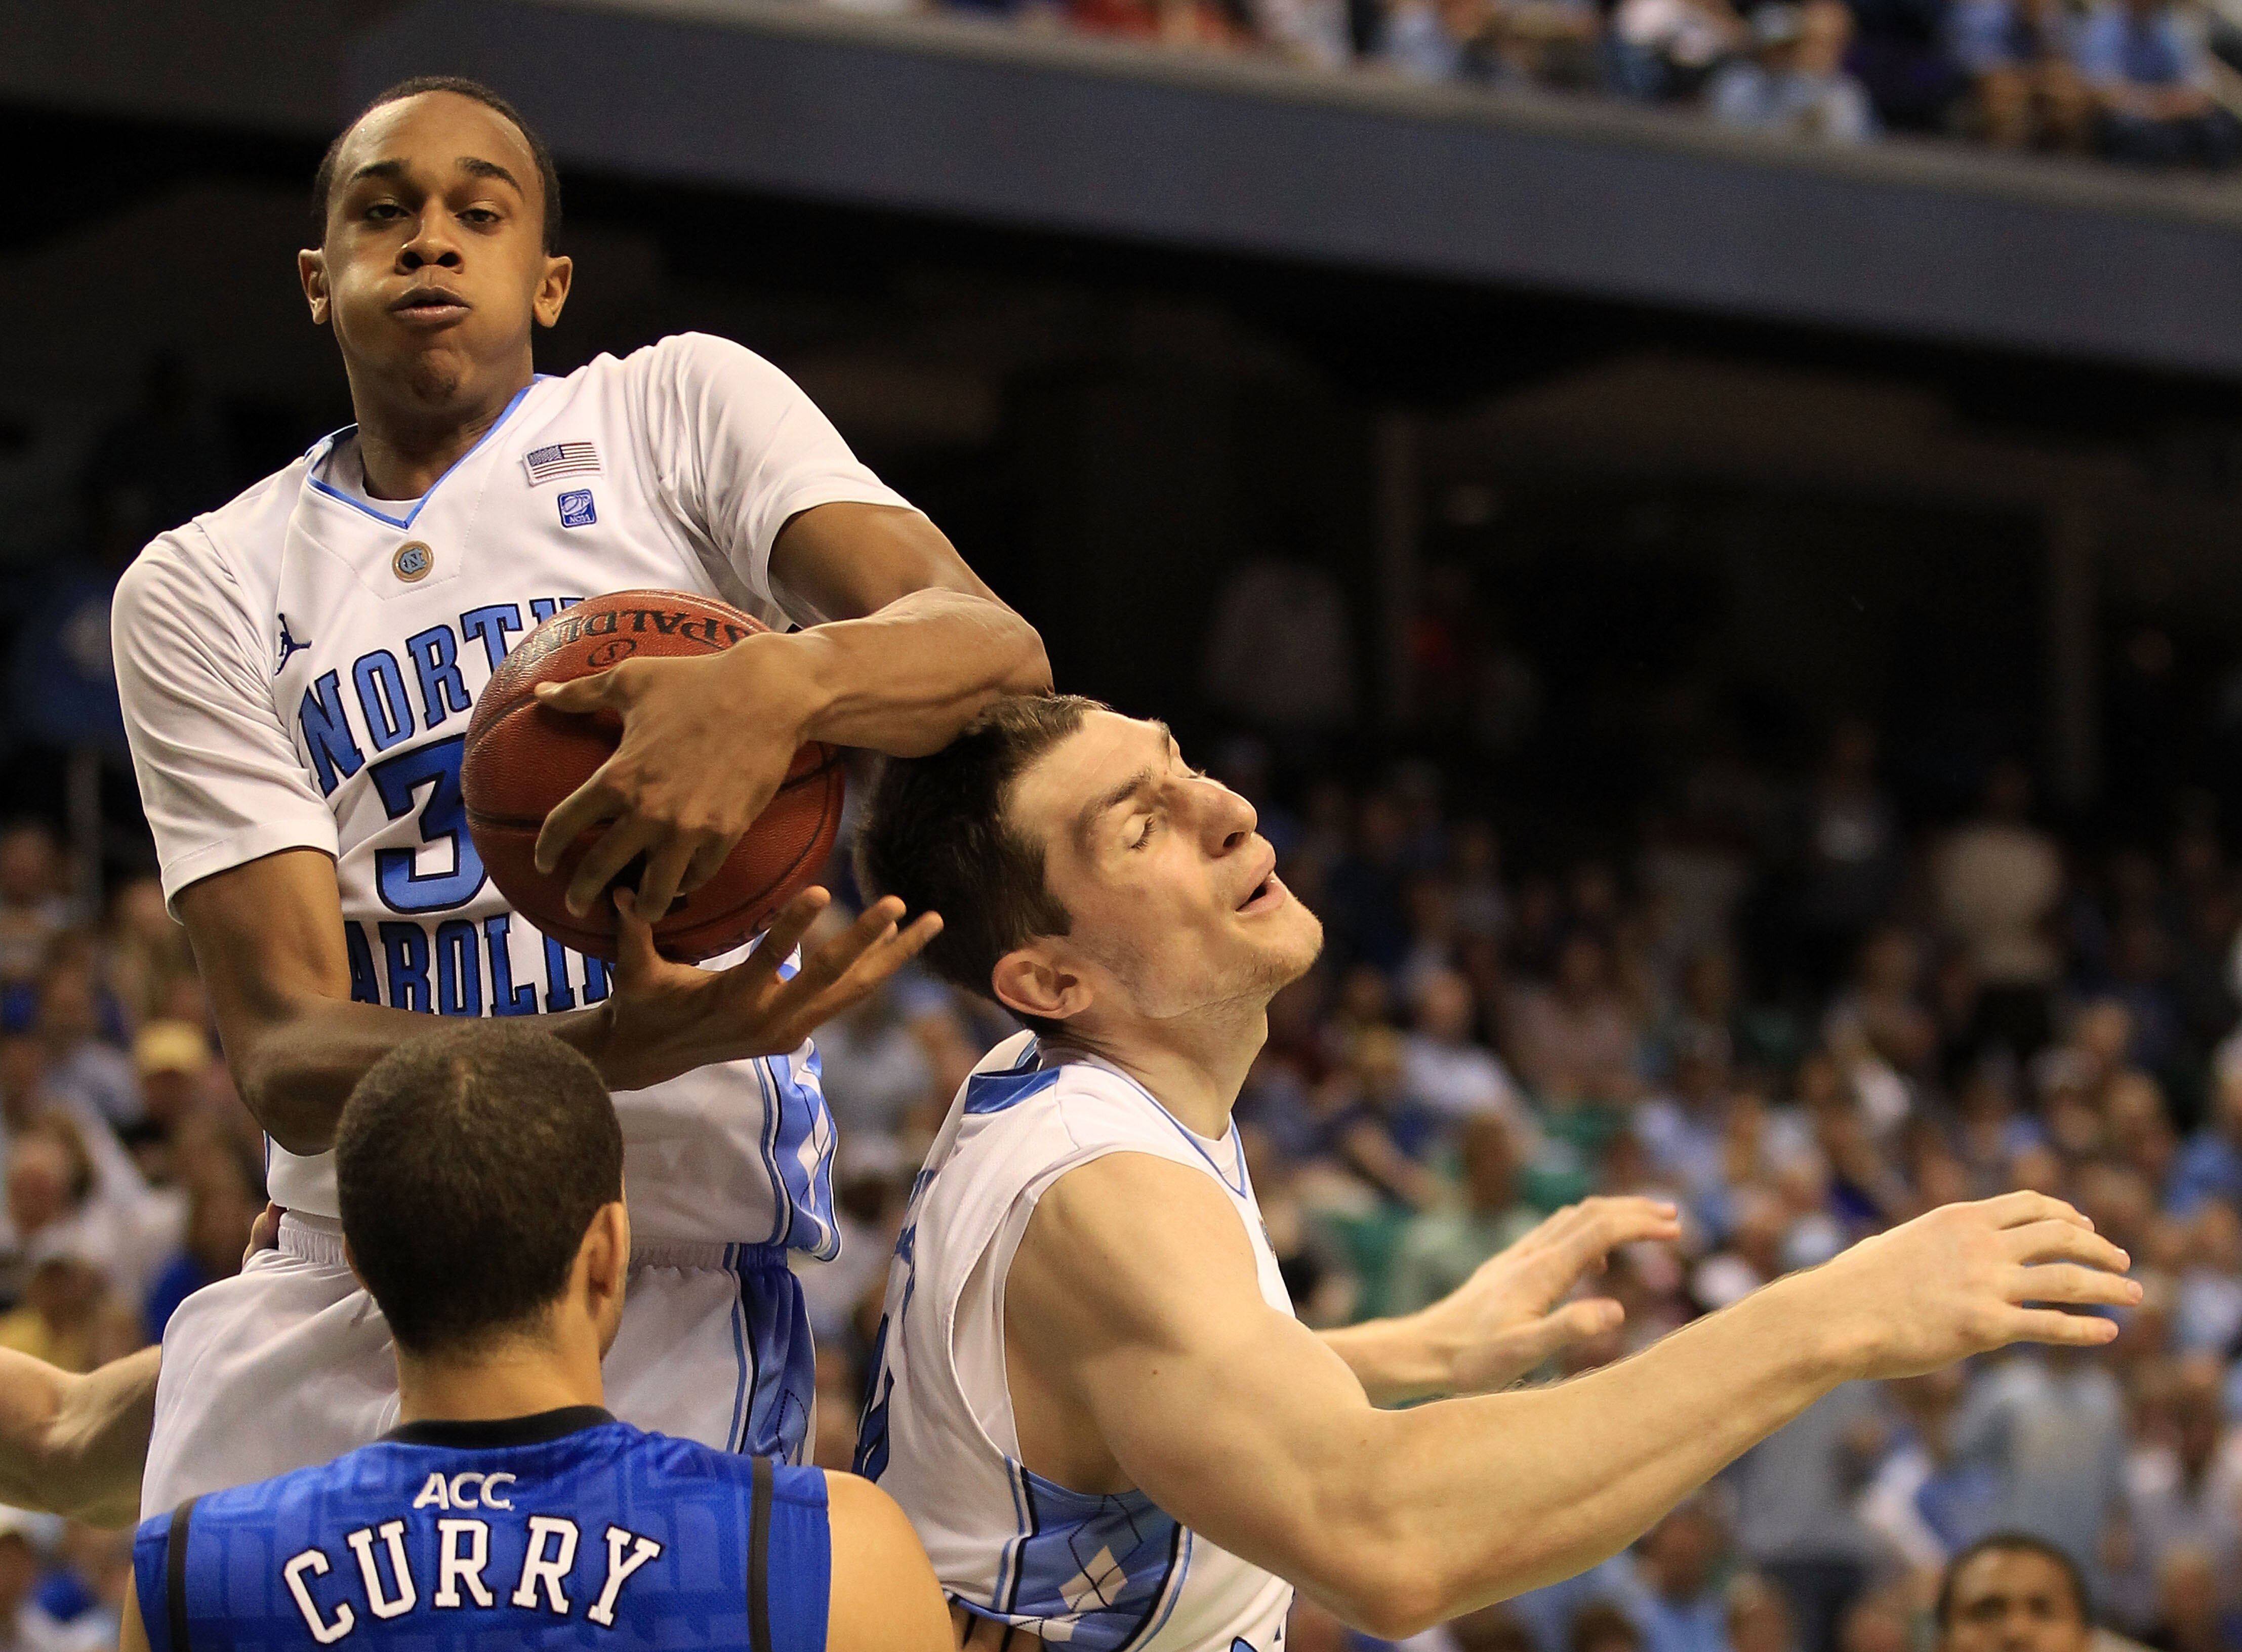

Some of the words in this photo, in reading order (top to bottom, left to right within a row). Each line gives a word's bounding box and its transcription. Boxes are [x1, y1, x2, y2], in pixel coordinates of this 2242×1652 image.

[299, 596, 585, 798] NORT
[413, 1472, 516, 1511] ACC
[282, 1515, 662, 1644] CURRY
